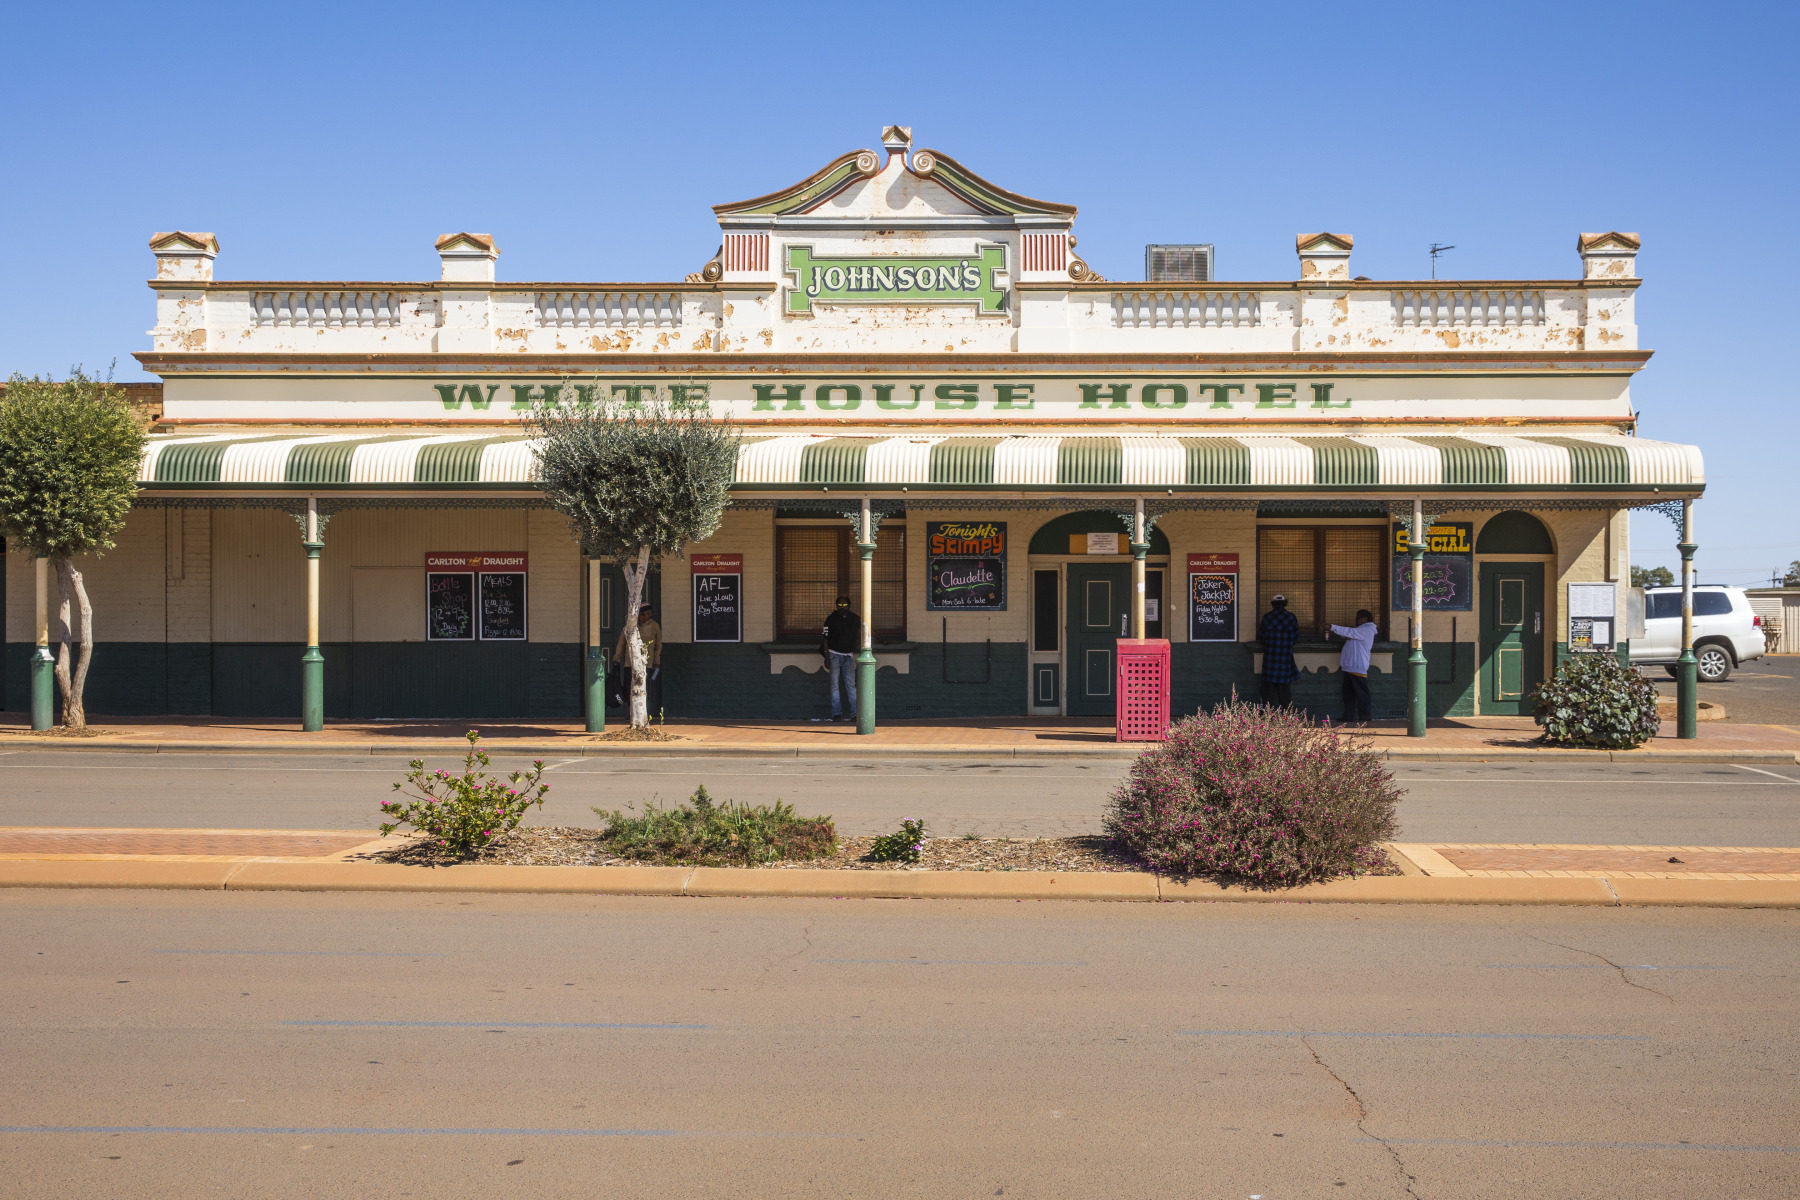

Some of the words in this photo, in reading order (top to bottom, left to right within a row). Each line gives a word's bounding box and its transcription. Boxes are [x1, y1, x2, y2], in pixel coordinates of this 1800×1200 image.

[806, 260, 981, 297] JOHNSON'S
[432, 384, 710, 412] WHITE
[750, 383, 1036, 412] HOUSE
[1077, 383, 1352, 411] HOTEL
[936, 523, 998, 540] Tonights
[932, 532, 1003, 554] SKIMPY
[427, 557, 466, 566] CARLTON
[483, 557, 525, 566] DRAUGHT
[699, 577, 730, 591] AFL
[940, 568, 994, 588] Claudette
[1197, 579, 1224, 590] Joker
[441, 592, 468, 608] Shop
